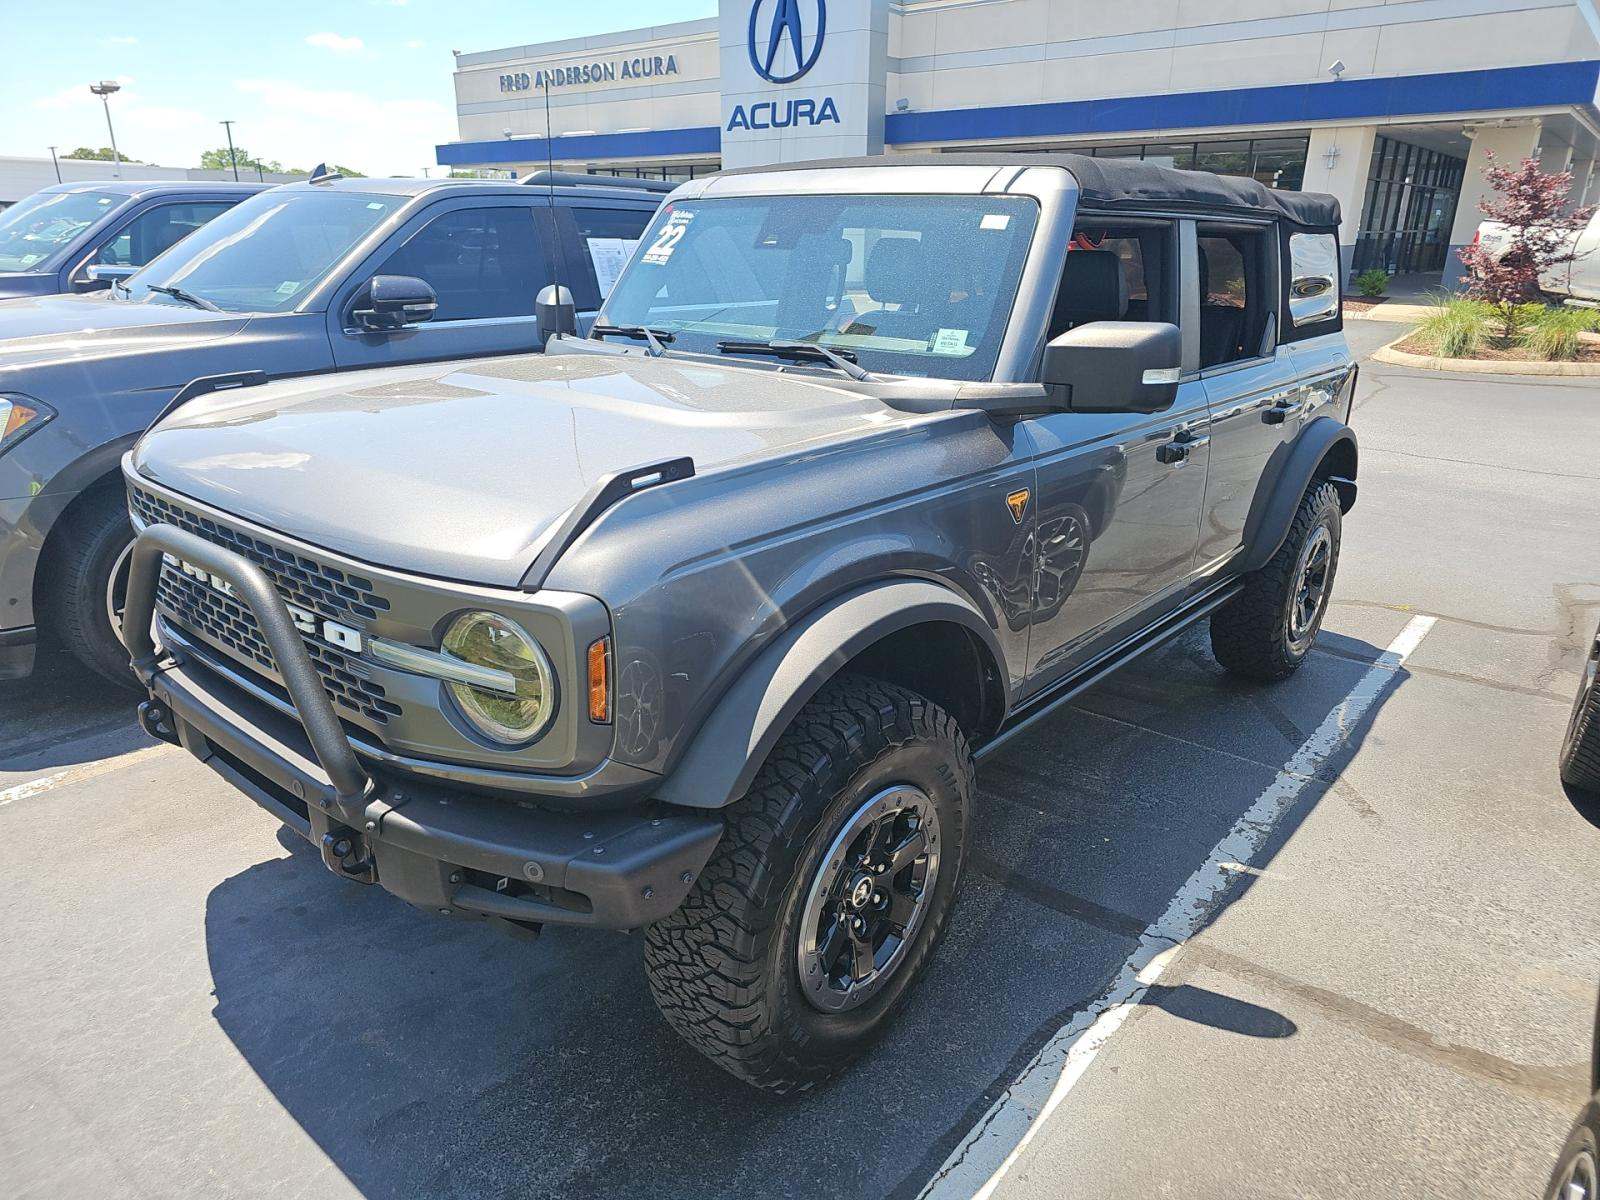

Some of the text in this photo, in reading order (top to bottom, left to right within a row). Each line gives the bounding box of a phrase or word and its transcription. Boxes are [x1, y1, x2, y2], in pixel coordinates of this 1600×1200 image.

[499, 55, 679, 93] FRED ANDERSON ACURA
[727, 97, 841, 132] ACURA
[646, 225, 686, 254] 22
